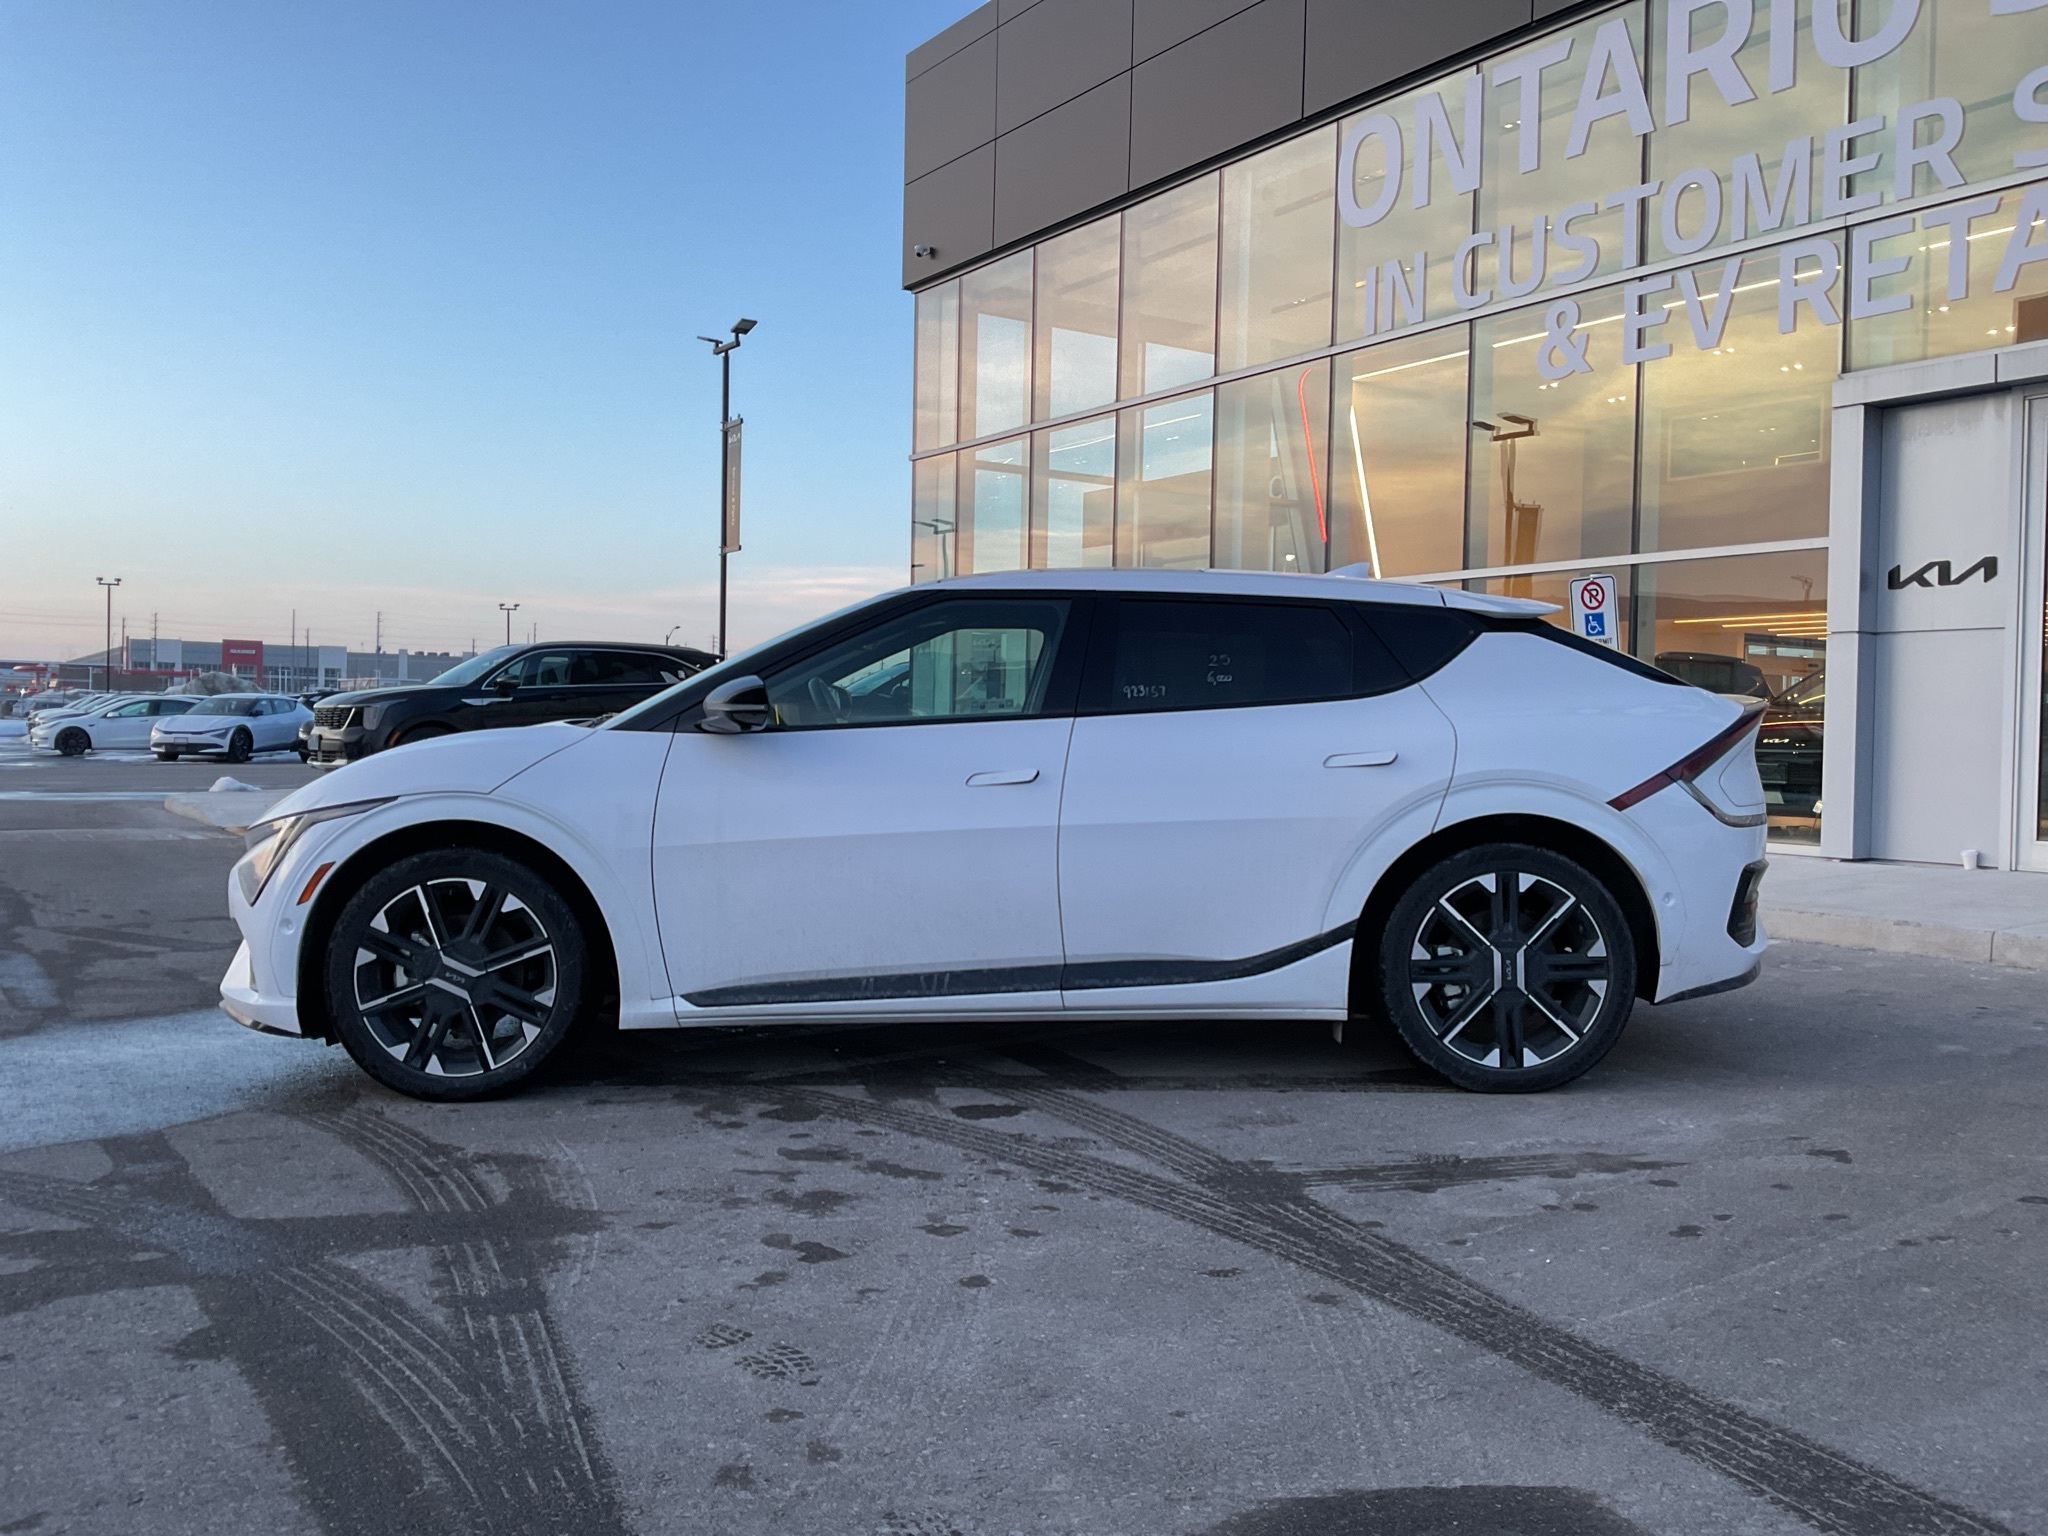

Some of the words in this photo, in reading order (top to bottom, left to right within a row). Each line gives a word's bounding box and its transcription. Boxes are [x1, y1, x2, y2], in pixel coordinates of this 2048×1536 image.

[1364, 252, 1427, 336] IN
[1452, 98, 1967, 310] CUSTOMER
[1536, 299, 1593, 380] &
[1622, 257, 1744, 364] EV
[1887, 556, 1998, 590] KIA
[1123, 685, 1166, 699] 923157
